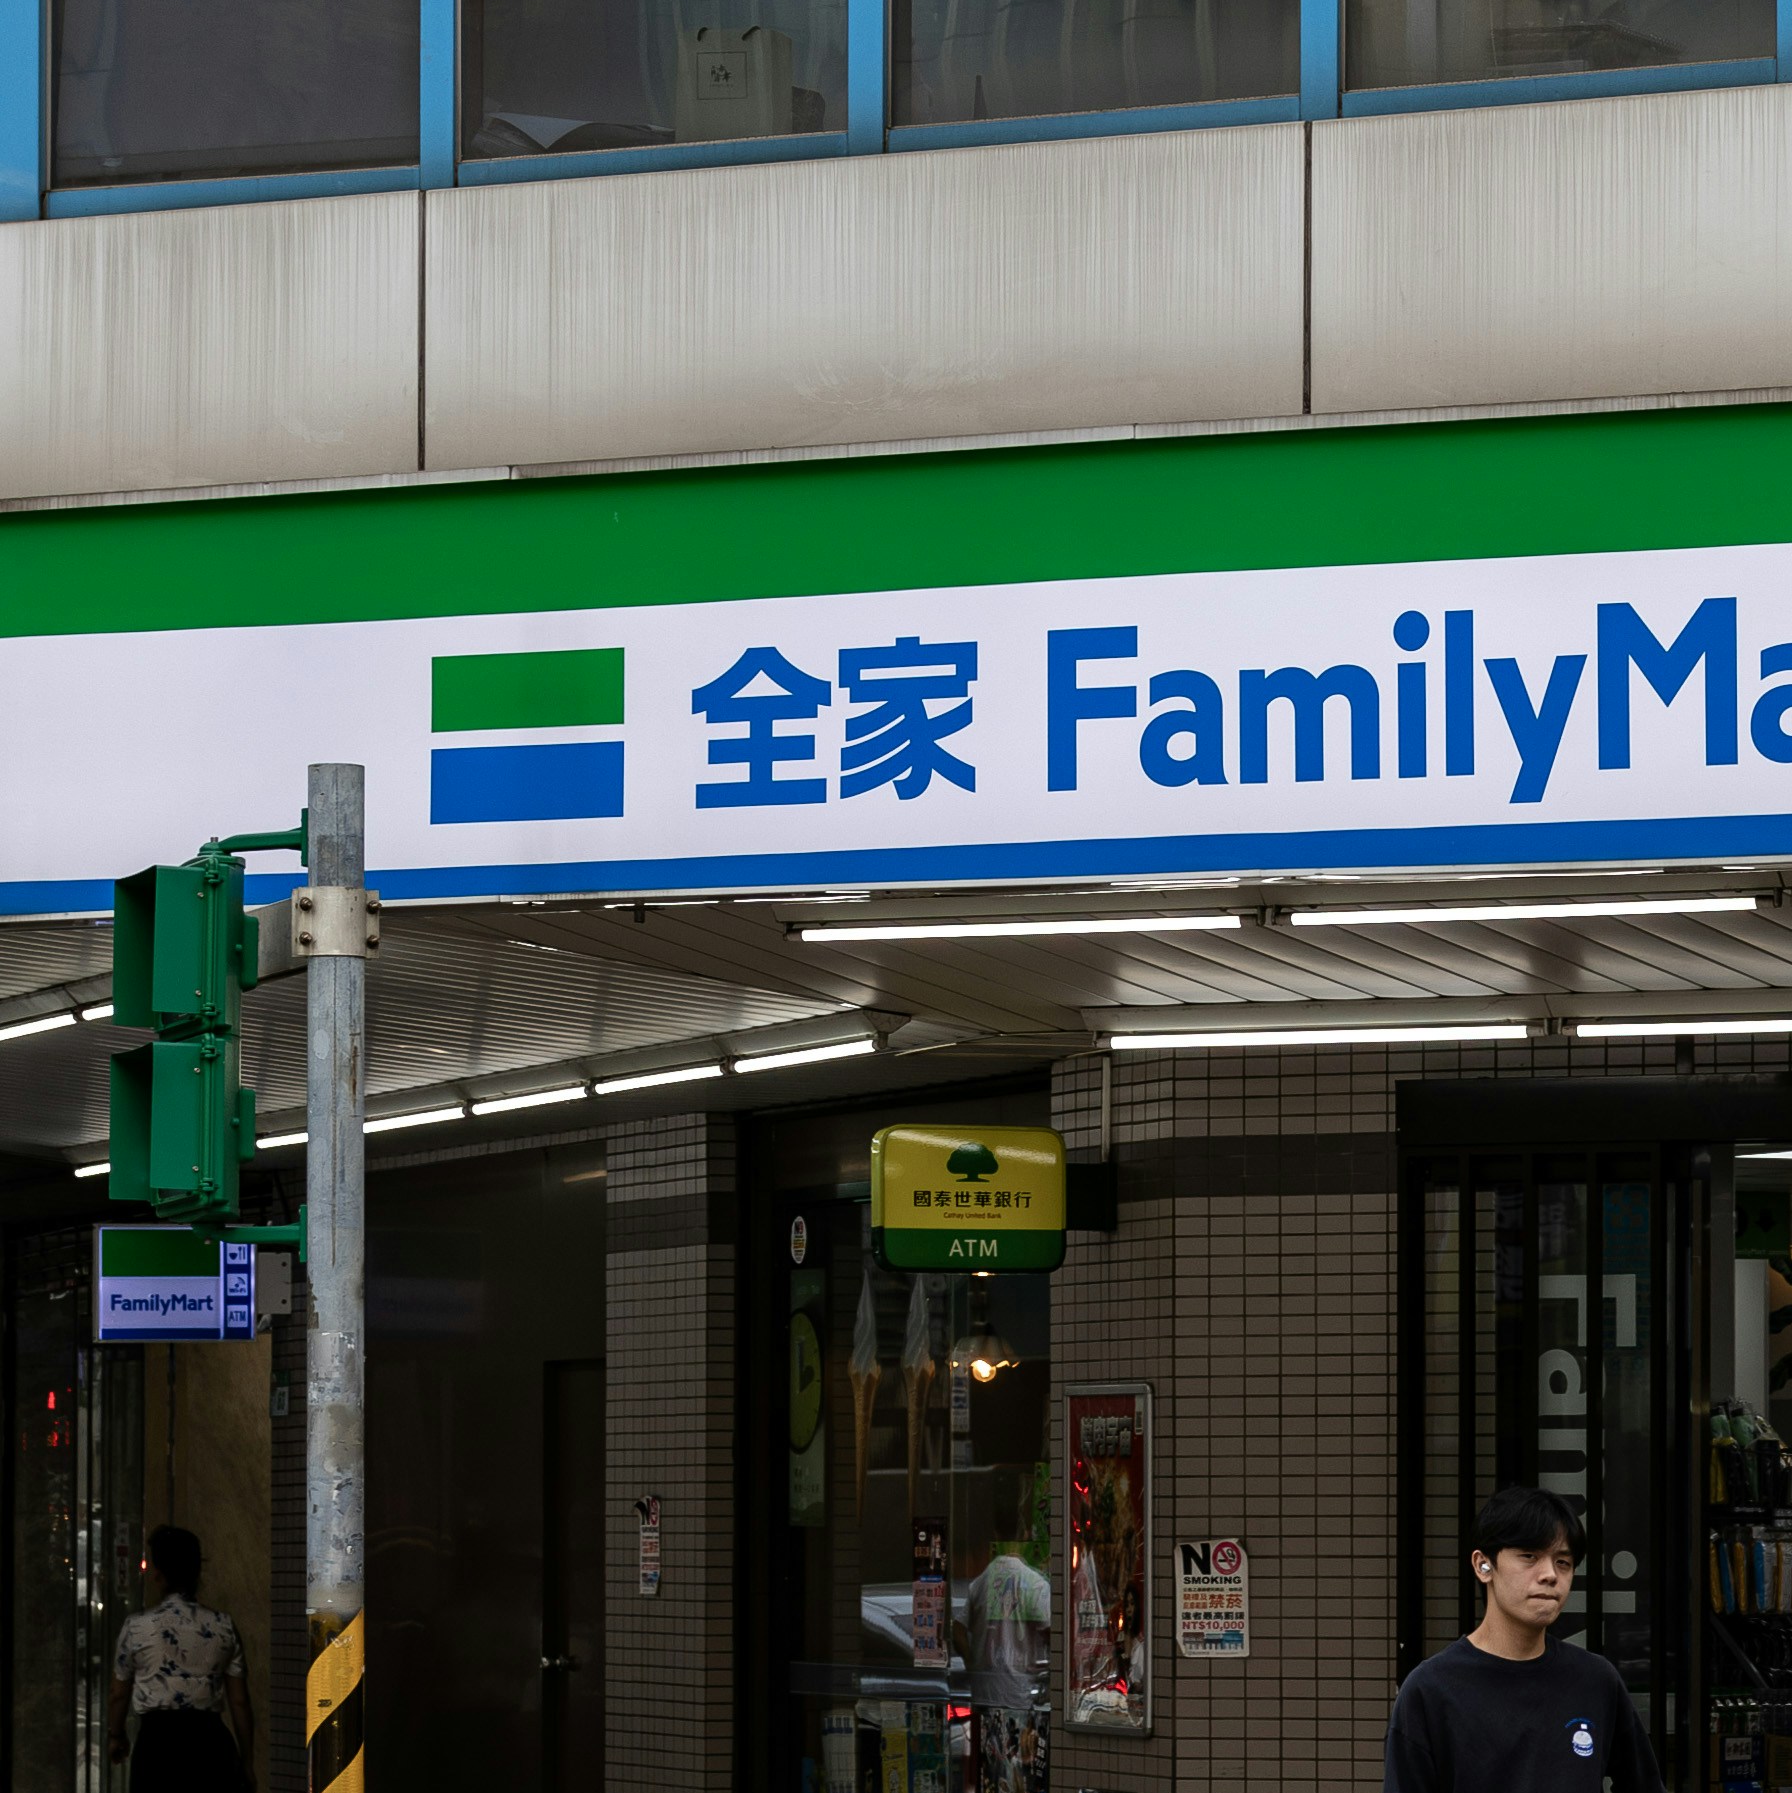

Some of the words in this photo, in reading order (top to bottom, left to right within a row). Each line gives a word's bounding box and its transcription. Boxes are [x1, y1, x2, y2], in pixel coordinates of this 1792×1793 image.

[692, 637, 978, 809] 全家
[913, 1190, 1033, 1209] 國泰世華銀行
[943, 1211, 965, 1220] Cathay
[965, 1211, 986, 1219] United
[987, 1211, 1002, 1219] Bank
[948, 1239, 999, 1258] ATM
[110, 1293, 214, 1316] FamilyMart
[228, 1310, 247, 1322] ATM
[1183, 1576, 1242, 1585] SMOKING
[1208, 1593, 1243, 1609] 禁菸
[1182, 1621, 1245, 1631] NT$10,000
